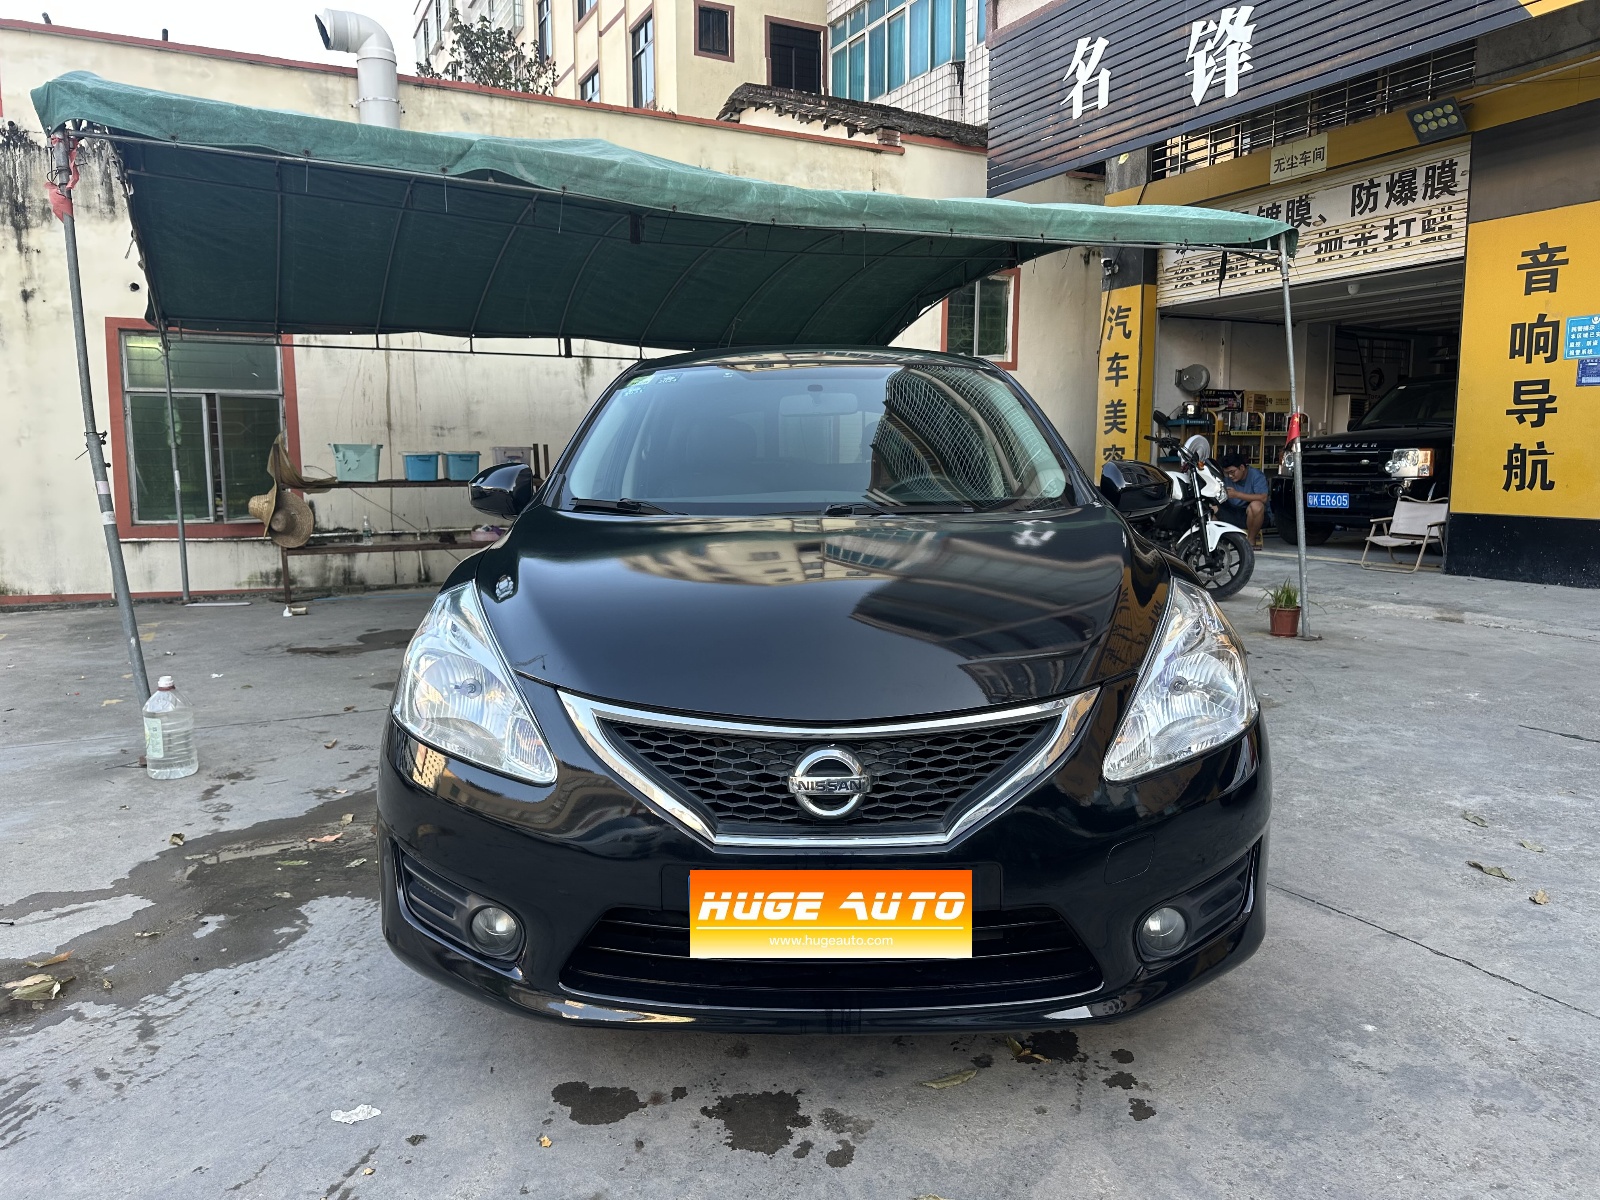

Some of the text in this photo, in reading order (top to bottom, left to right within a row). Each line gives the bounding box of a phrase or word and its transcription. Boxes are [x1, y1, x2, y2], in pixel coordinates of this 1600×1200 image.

[1273, 146, 1326, 174] 无尘车间
[1502, 241, 1570, 492] 音响导航
[797, 779, 863, 792] NISSAN
